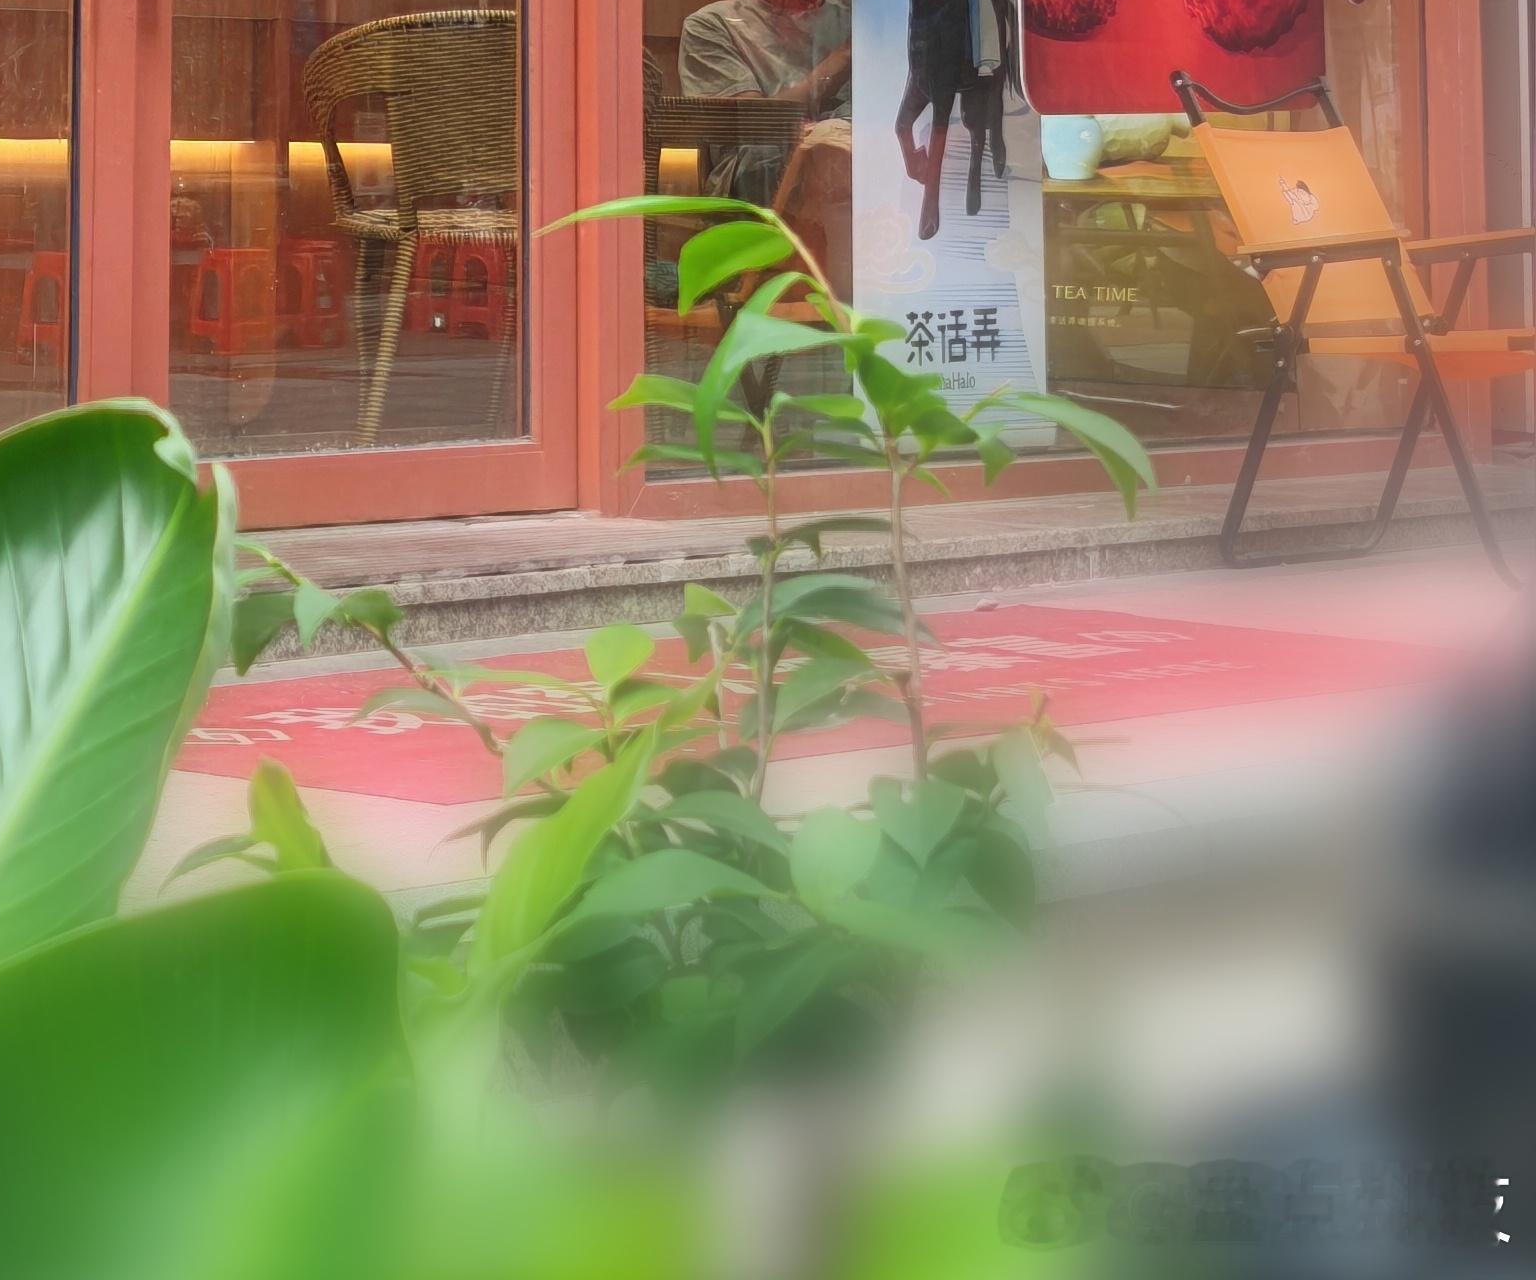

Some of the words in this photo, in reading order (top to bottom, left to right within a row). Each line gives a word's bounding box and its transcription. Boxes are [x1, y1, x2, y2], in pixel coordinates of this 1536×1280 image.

[1052, 283, 1087, 301] TEA
[1093, 285, 1139, 303] TIME
[905, 307, 1002, 366] 茶话弄
